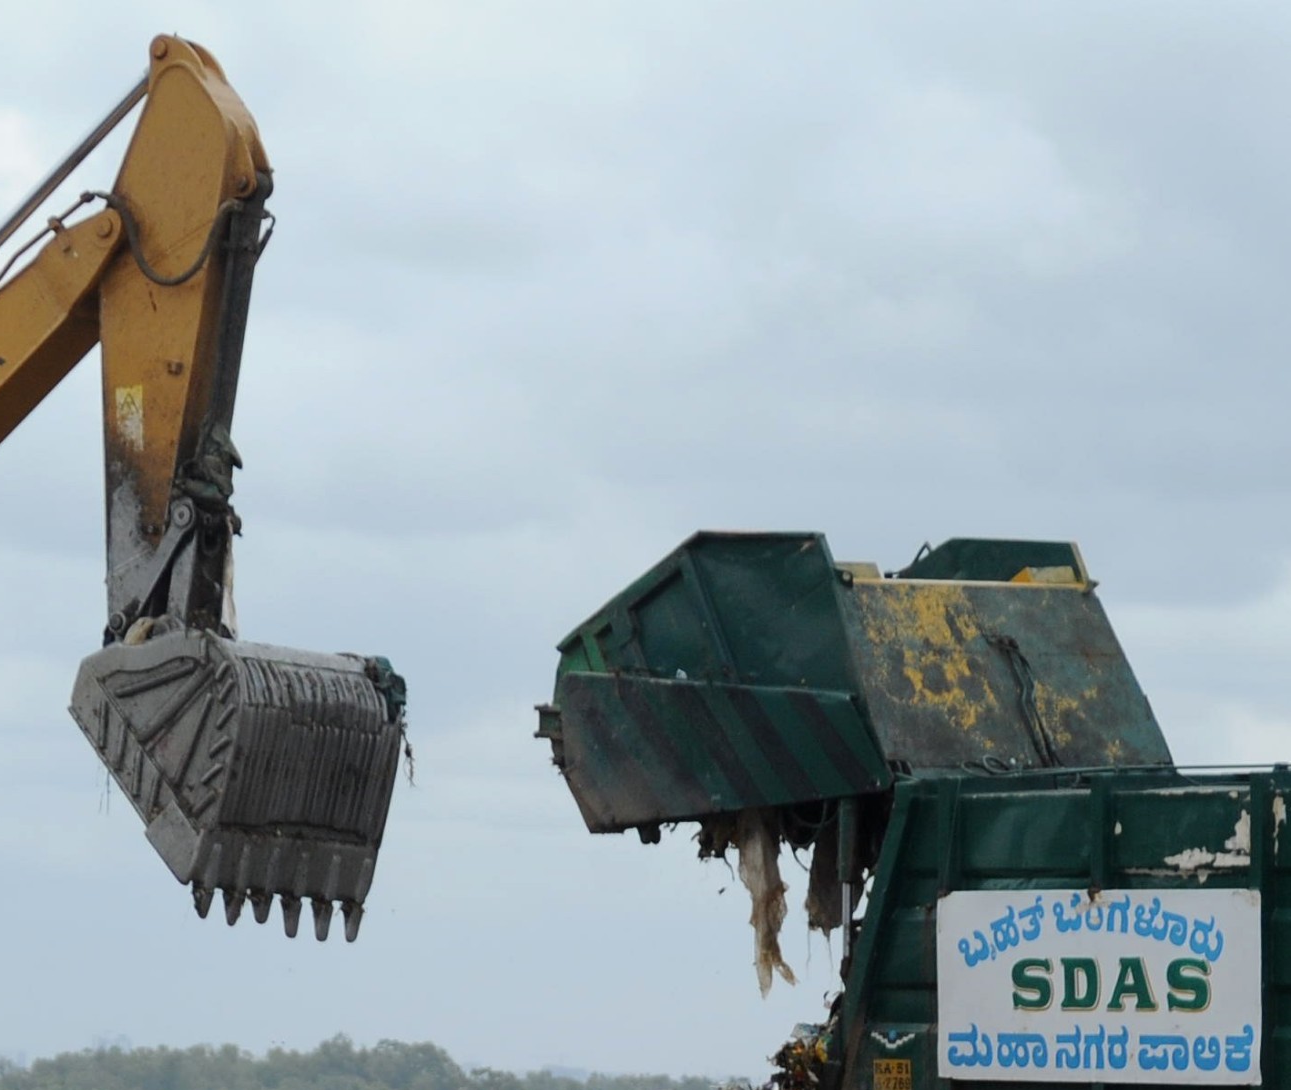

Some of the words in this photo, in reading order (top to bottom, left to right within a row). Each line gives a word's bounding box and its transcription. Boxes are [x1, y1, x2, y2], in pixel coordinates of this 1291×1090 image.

[958, 895, 1044, 968] ಬೃಹತ್
[1052, 892, 1224, 962] ಬೆಂಗಳೂರು
[1011, 956, 1212, 1012] SDAS
[1137, 1023, 1255, 1073] ಪಾಲಿಕೆ
